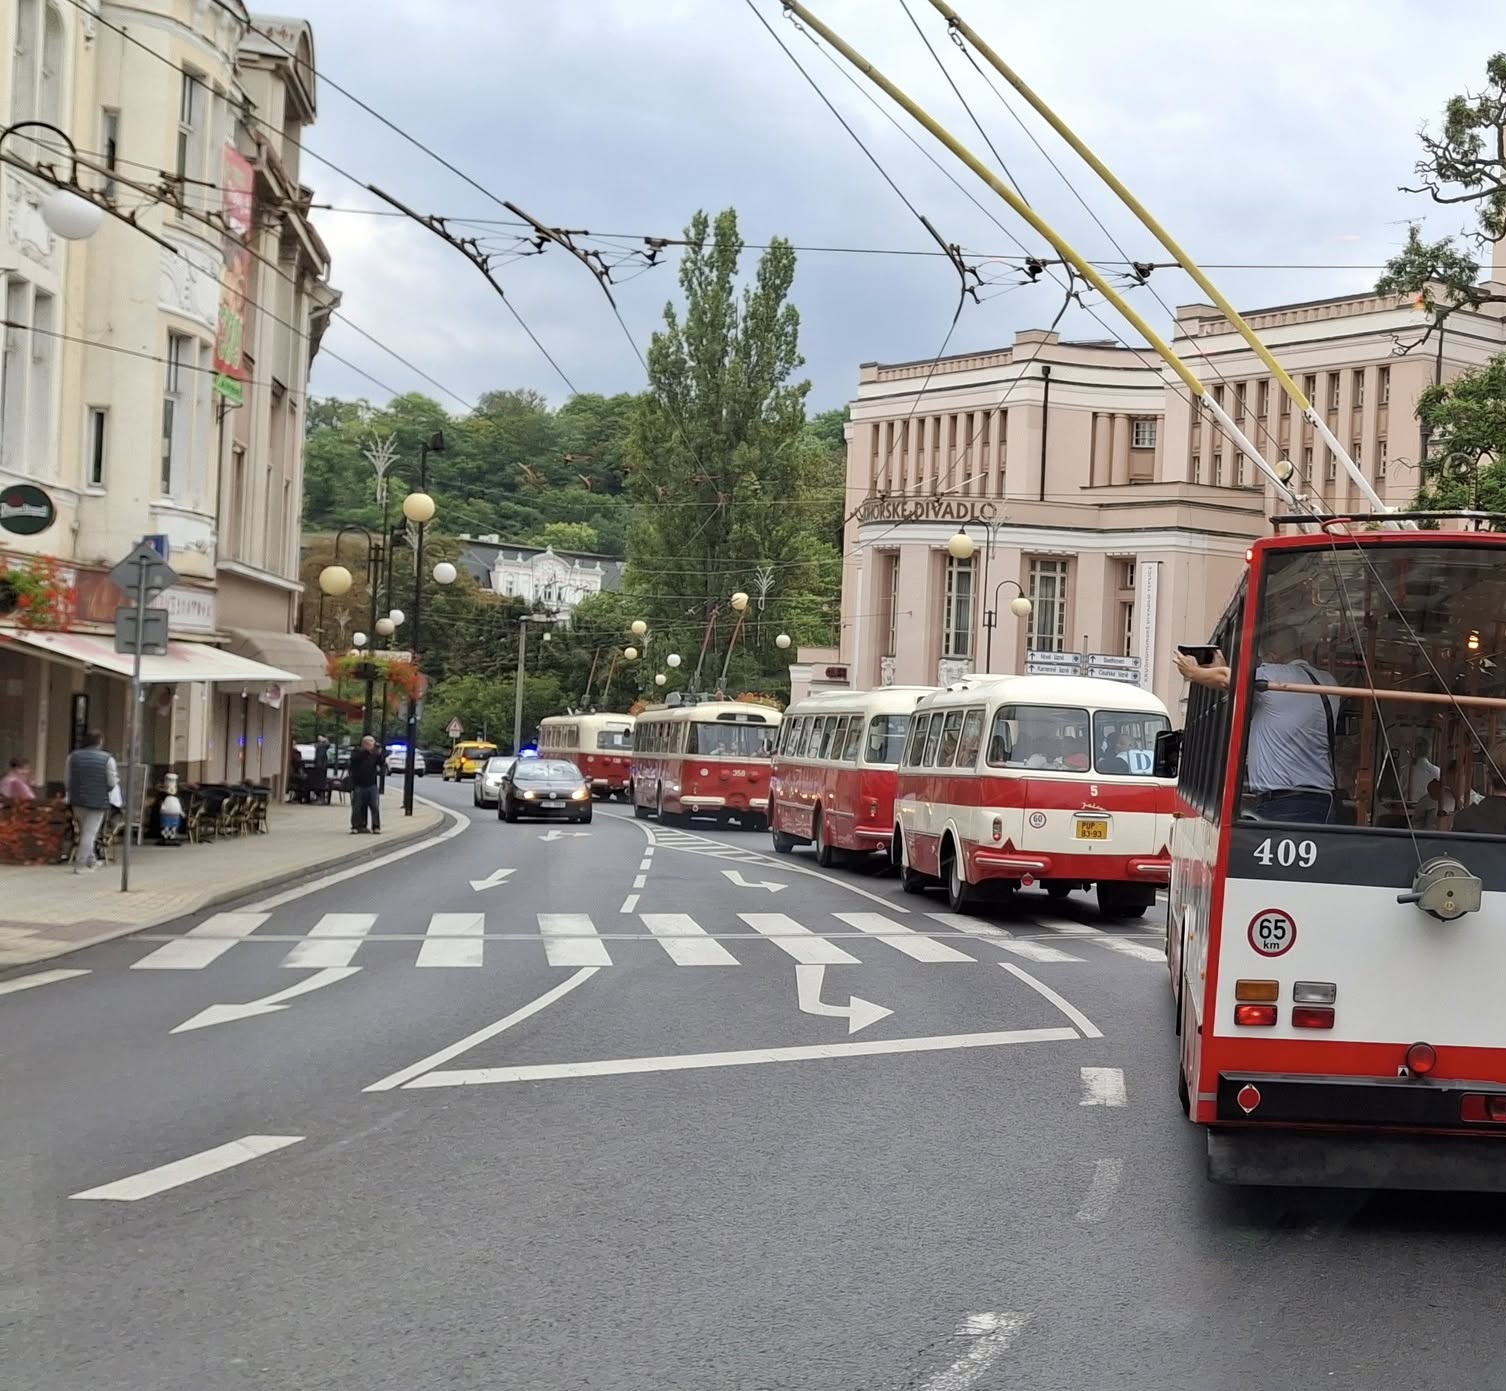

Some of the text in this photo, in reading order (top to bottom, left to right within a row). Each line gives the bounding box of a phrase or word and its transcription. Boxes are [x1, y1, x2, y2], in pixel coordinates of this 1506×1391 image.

[914, 501, 998, 520] DIVADLO
[1135, 753, 1152, 771] D
[1090, 784, 1098, 797] 5
[1253, 838, 1317, 868] 409
[1259, 918, 1286, 940] 65
[1263, 940, 1280, 950] km
